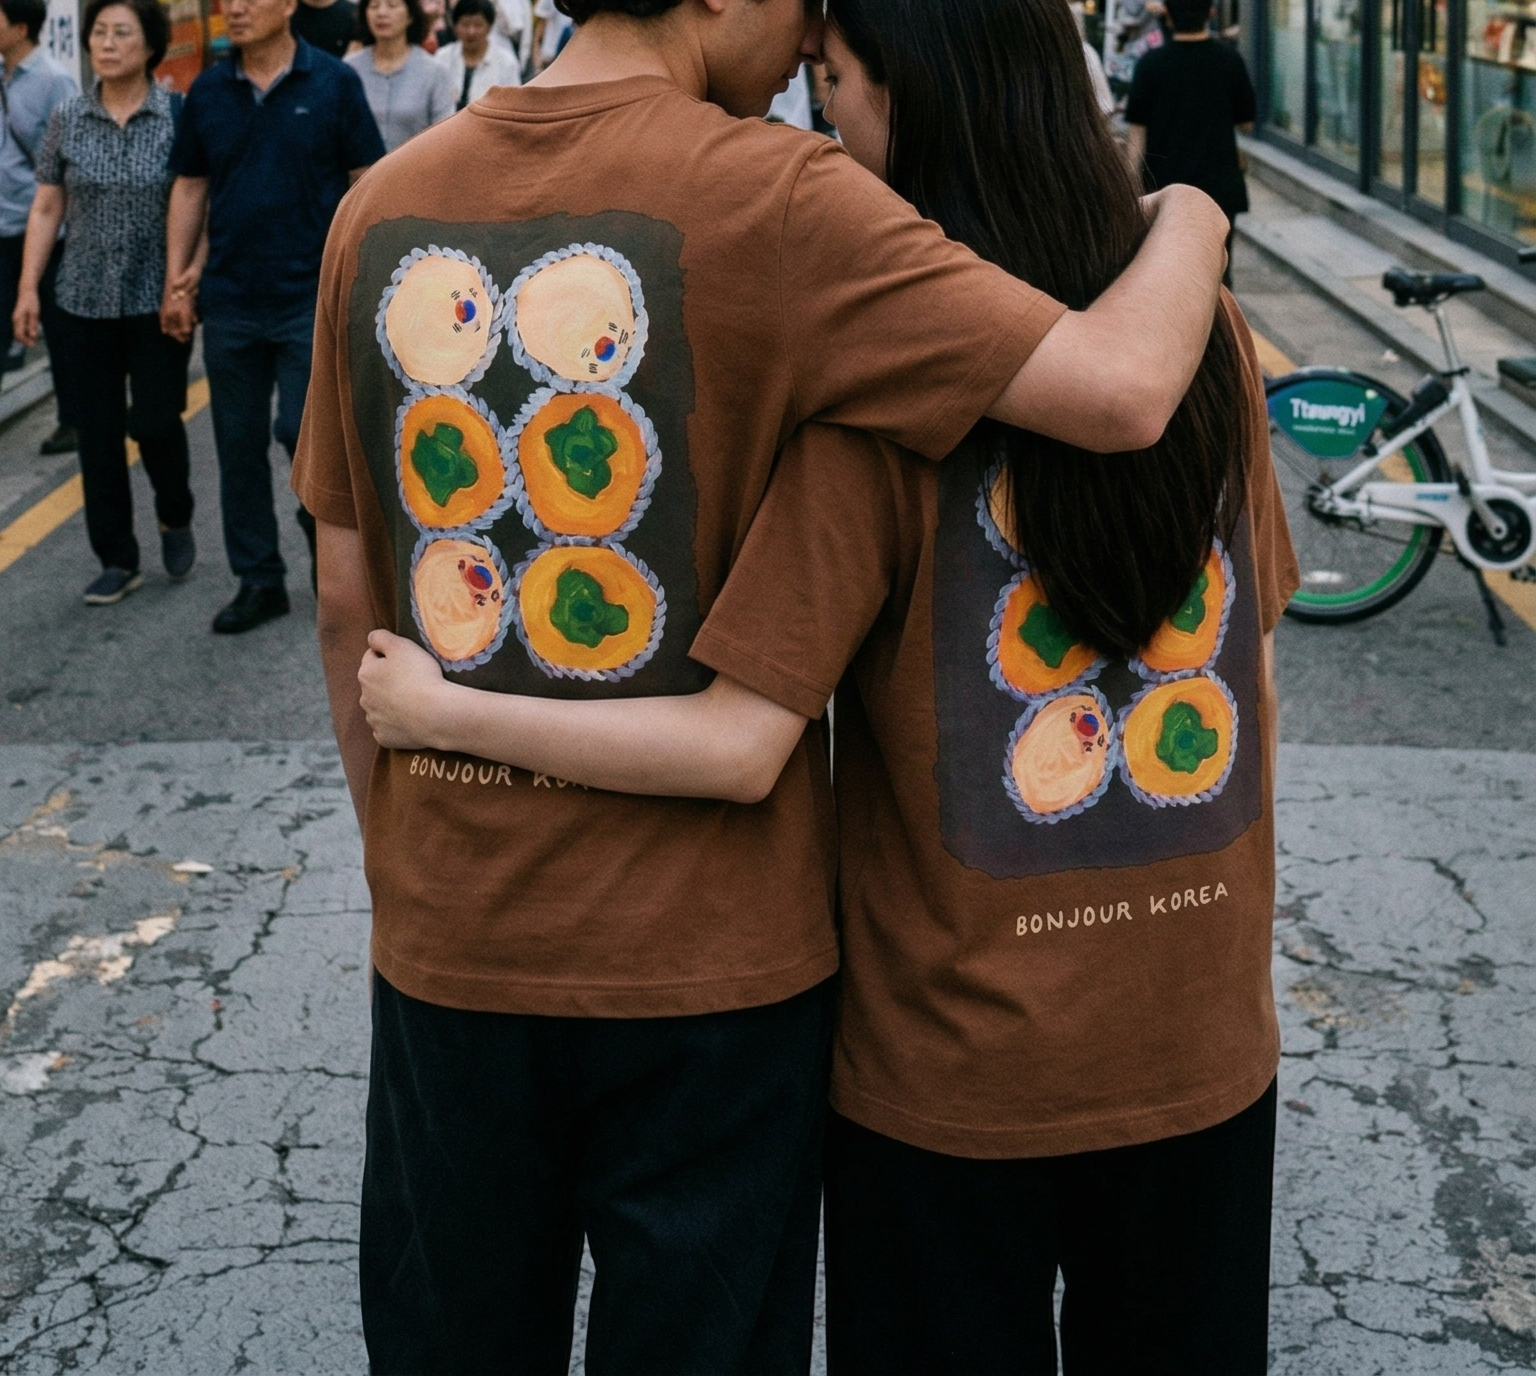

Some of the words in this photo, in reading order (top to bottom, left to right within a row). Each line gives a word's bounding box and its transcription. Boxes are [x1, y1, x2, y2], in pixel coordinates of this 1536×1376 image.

[410, 755, 513, 787] BONJOUR
[1016, 901, 1133, 937] BONJOUR
[1150, 882, 1229, 916] KOREA
